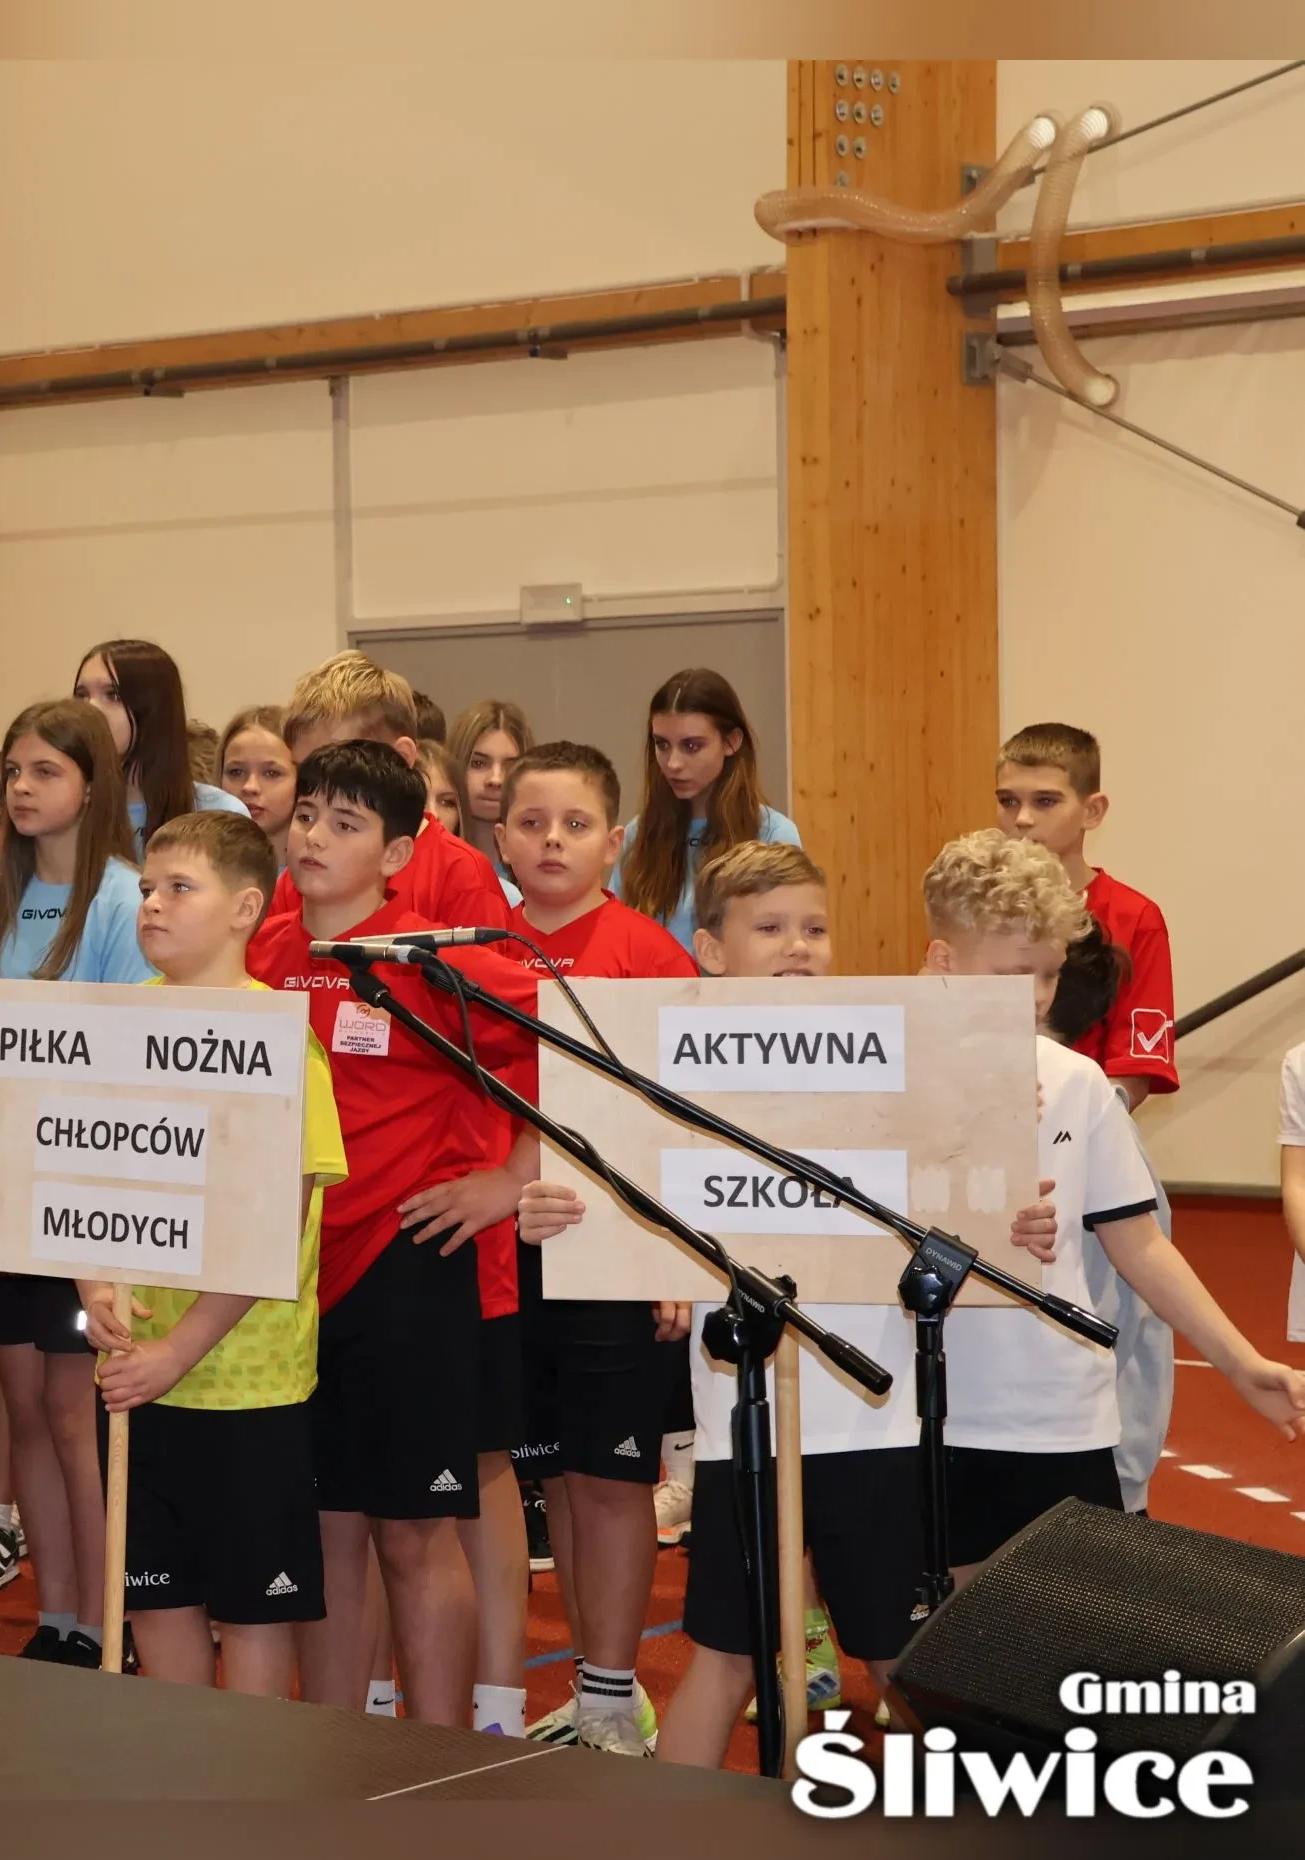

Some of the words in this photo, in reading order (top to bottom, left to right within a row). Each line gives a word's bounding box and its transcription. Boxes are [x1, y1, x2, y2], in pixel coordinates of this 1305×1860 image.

[22, 907, 67, 920] GIVOV
[519, 957, 575, 969] VOVA
[283, 975, 351, 990] GIVOVA
[339, 1018, 387, 1032] WORD
[0, 1027, 91, 1066] PIŁKA
[146, 1028, 272, 1077] NOŻNA
[673, 1032, 888, 1065] AKTYWNA
[36, 1116, 205, 1158] CHŁOPCÓW
[43, 1206, 189, 1250] MŁODYCH
[925, 1247, 962, 1271] DYNAWID
[737, 1287, 765, 1313] YNAWID
[614, 1447, 641, 1458] adidas
[429, 1483, 463, 1492] adidas
[124, 1571, 171, 1587] iwice
[265, 1584, 299, 1596] adidas
